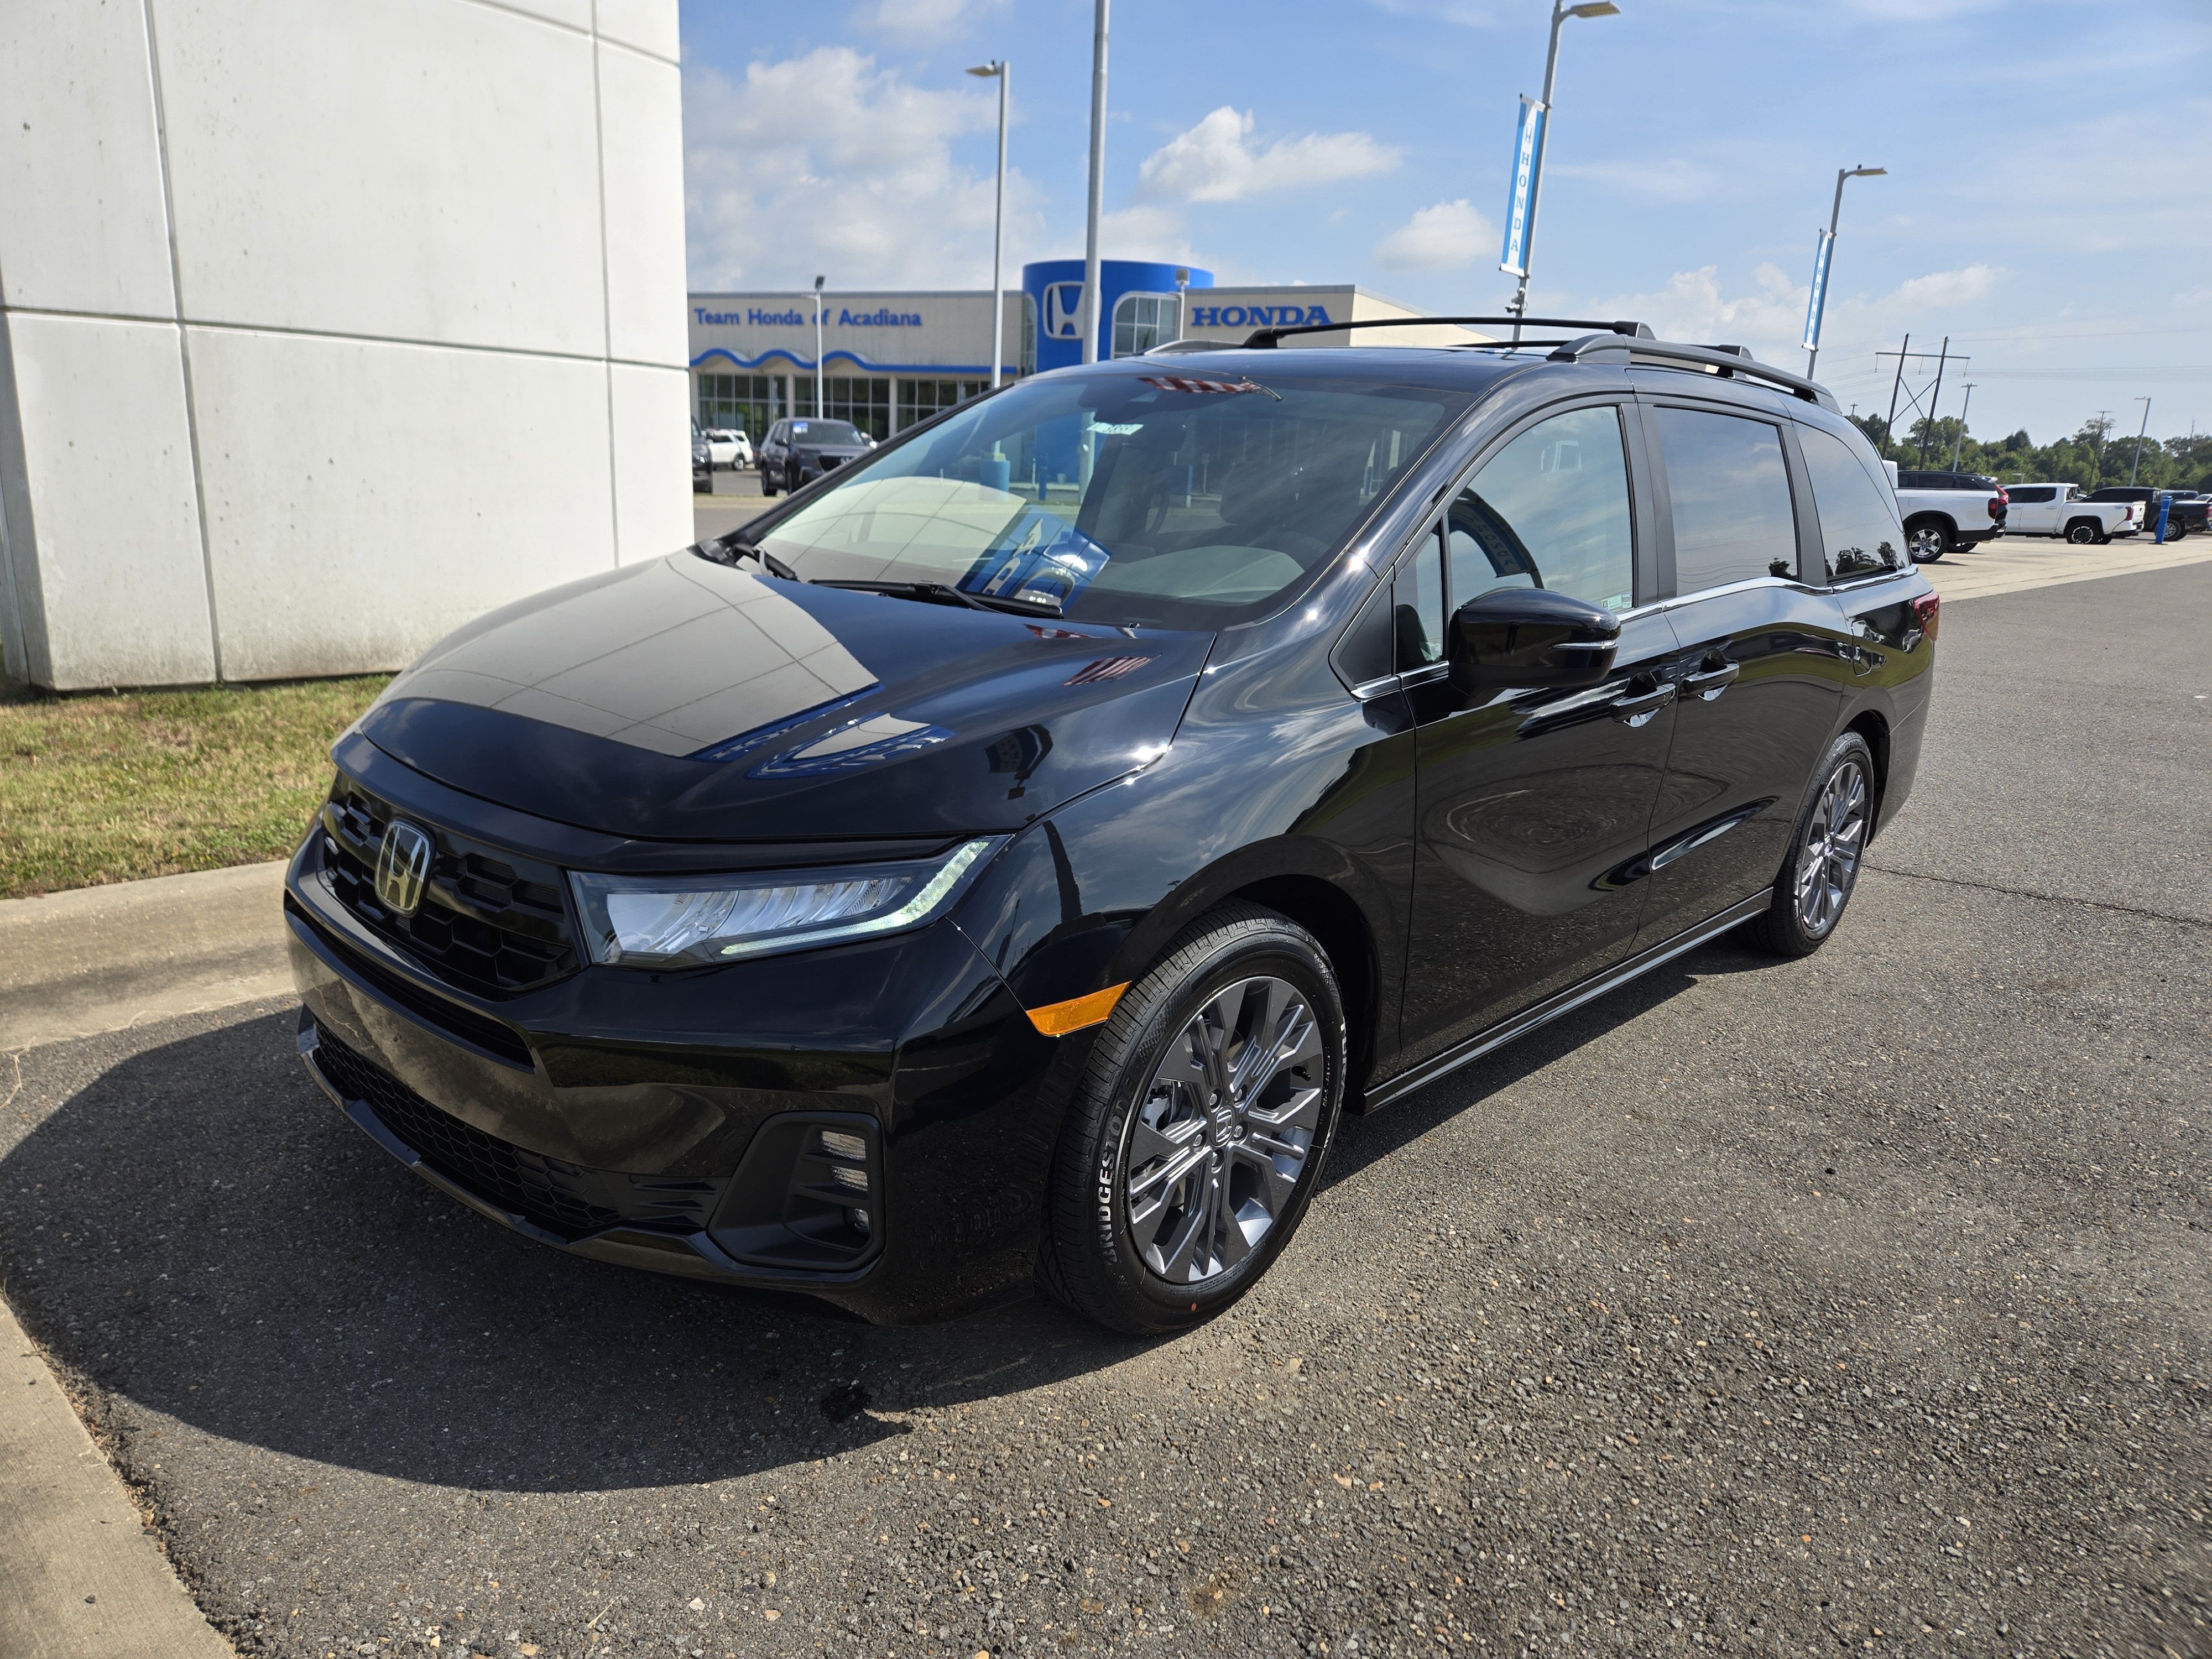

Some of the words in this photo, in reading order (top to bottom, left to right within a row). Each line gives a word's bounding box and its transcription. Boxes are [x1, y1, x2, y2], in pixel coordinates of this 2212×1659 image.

[1511, 152, 1530, 253] HONDA
[695, 308, 740, 325] Team
[748, 308, 804, 326] Honda
[838, 307, 923, 326] Acadiana
[1192, 306, 1332, 326] HONDA
